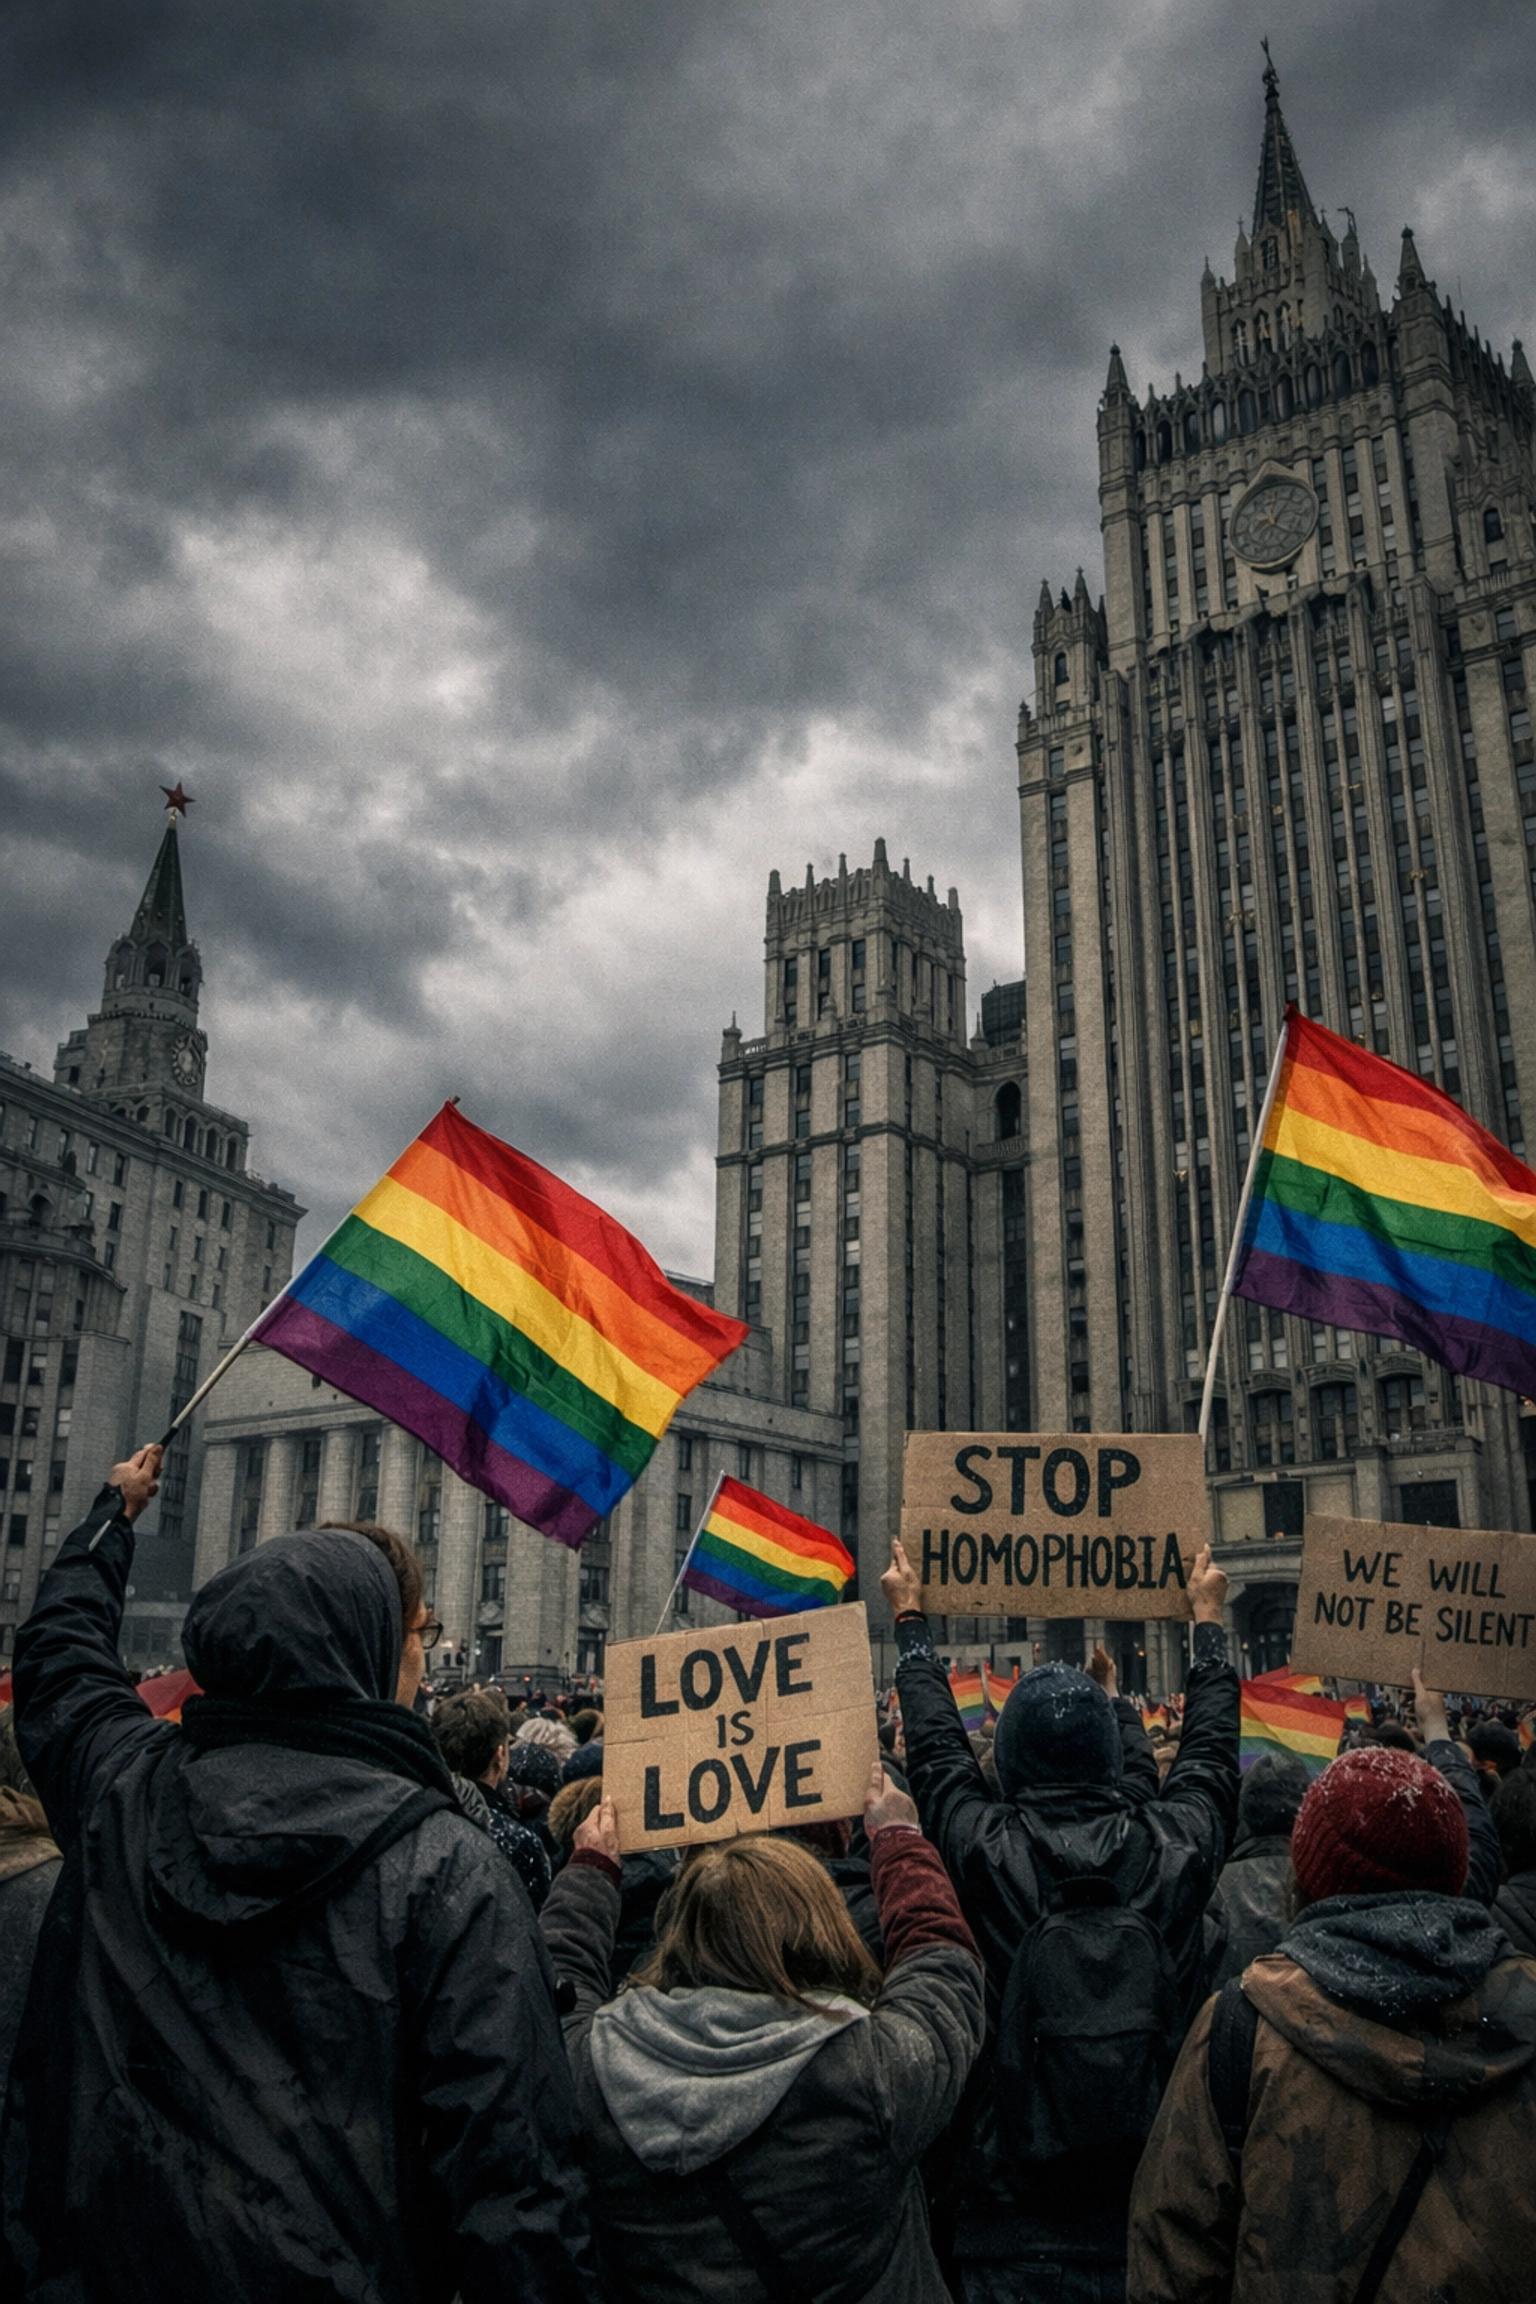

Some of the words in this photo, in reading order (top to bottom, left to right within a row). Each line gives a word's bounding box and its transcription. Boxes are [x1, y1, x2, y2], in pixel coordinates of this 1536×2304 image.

[950, 1445, 1141, 1517] STOP
[922, 1529, 1186, 1589] HOMOPHOBIA
[1344, 1550, 1403, 1588] WE
[1429, 1559, 1506, 1599] WILL
[1314, 1591, 1375, 1631] NOT
[1385, 1601, 1423, 1636] BE
[1435, 1607, 1536, 1648] SILENT
[640, 1632, 813, 1719] LOVE
[716, 1710, 754, 1748] IS
[644, 1739, 822, 1831] LOVE
